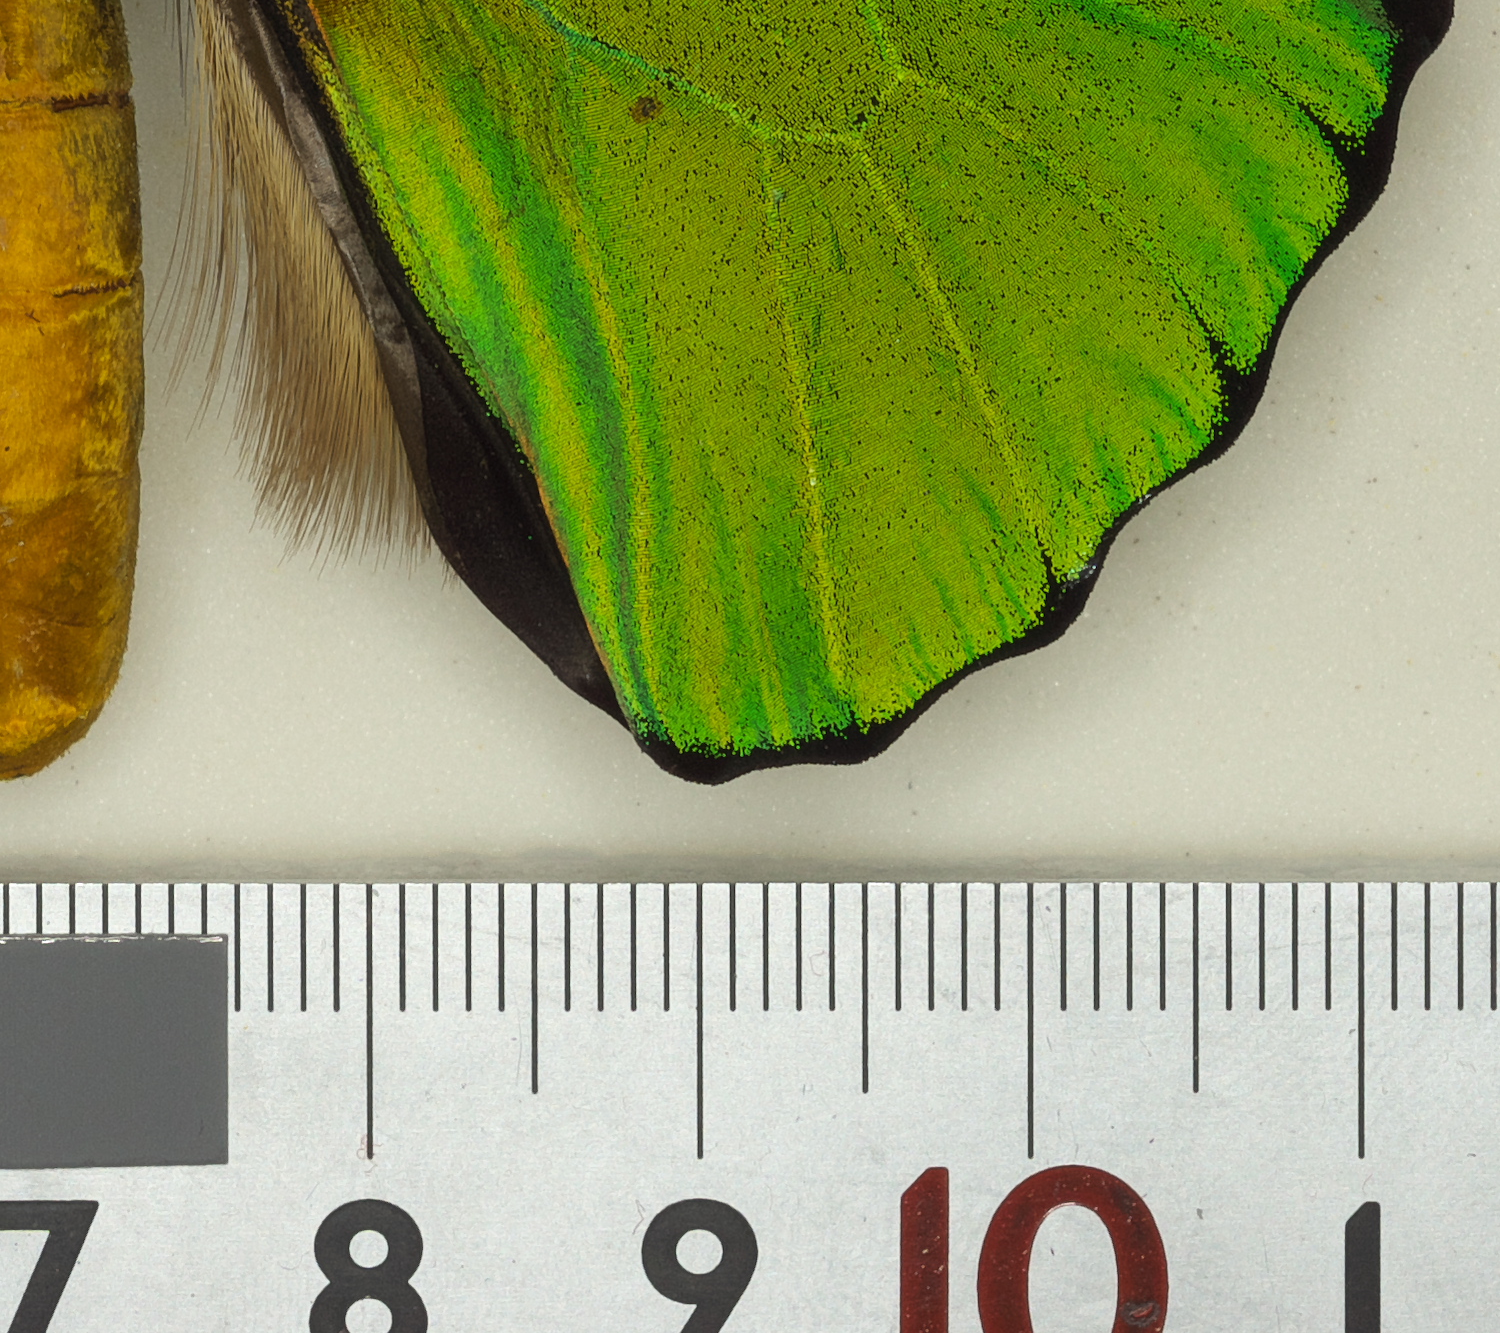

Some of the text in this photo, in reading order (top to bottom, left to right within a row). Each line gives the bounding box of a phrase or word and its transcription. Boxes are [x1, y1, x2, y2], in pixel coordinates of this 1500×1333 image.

[307, 1197, 430, 1333] 8
[640, 1197, 760, 1333] 9
[900, 1164, 1170, 1333] 10
